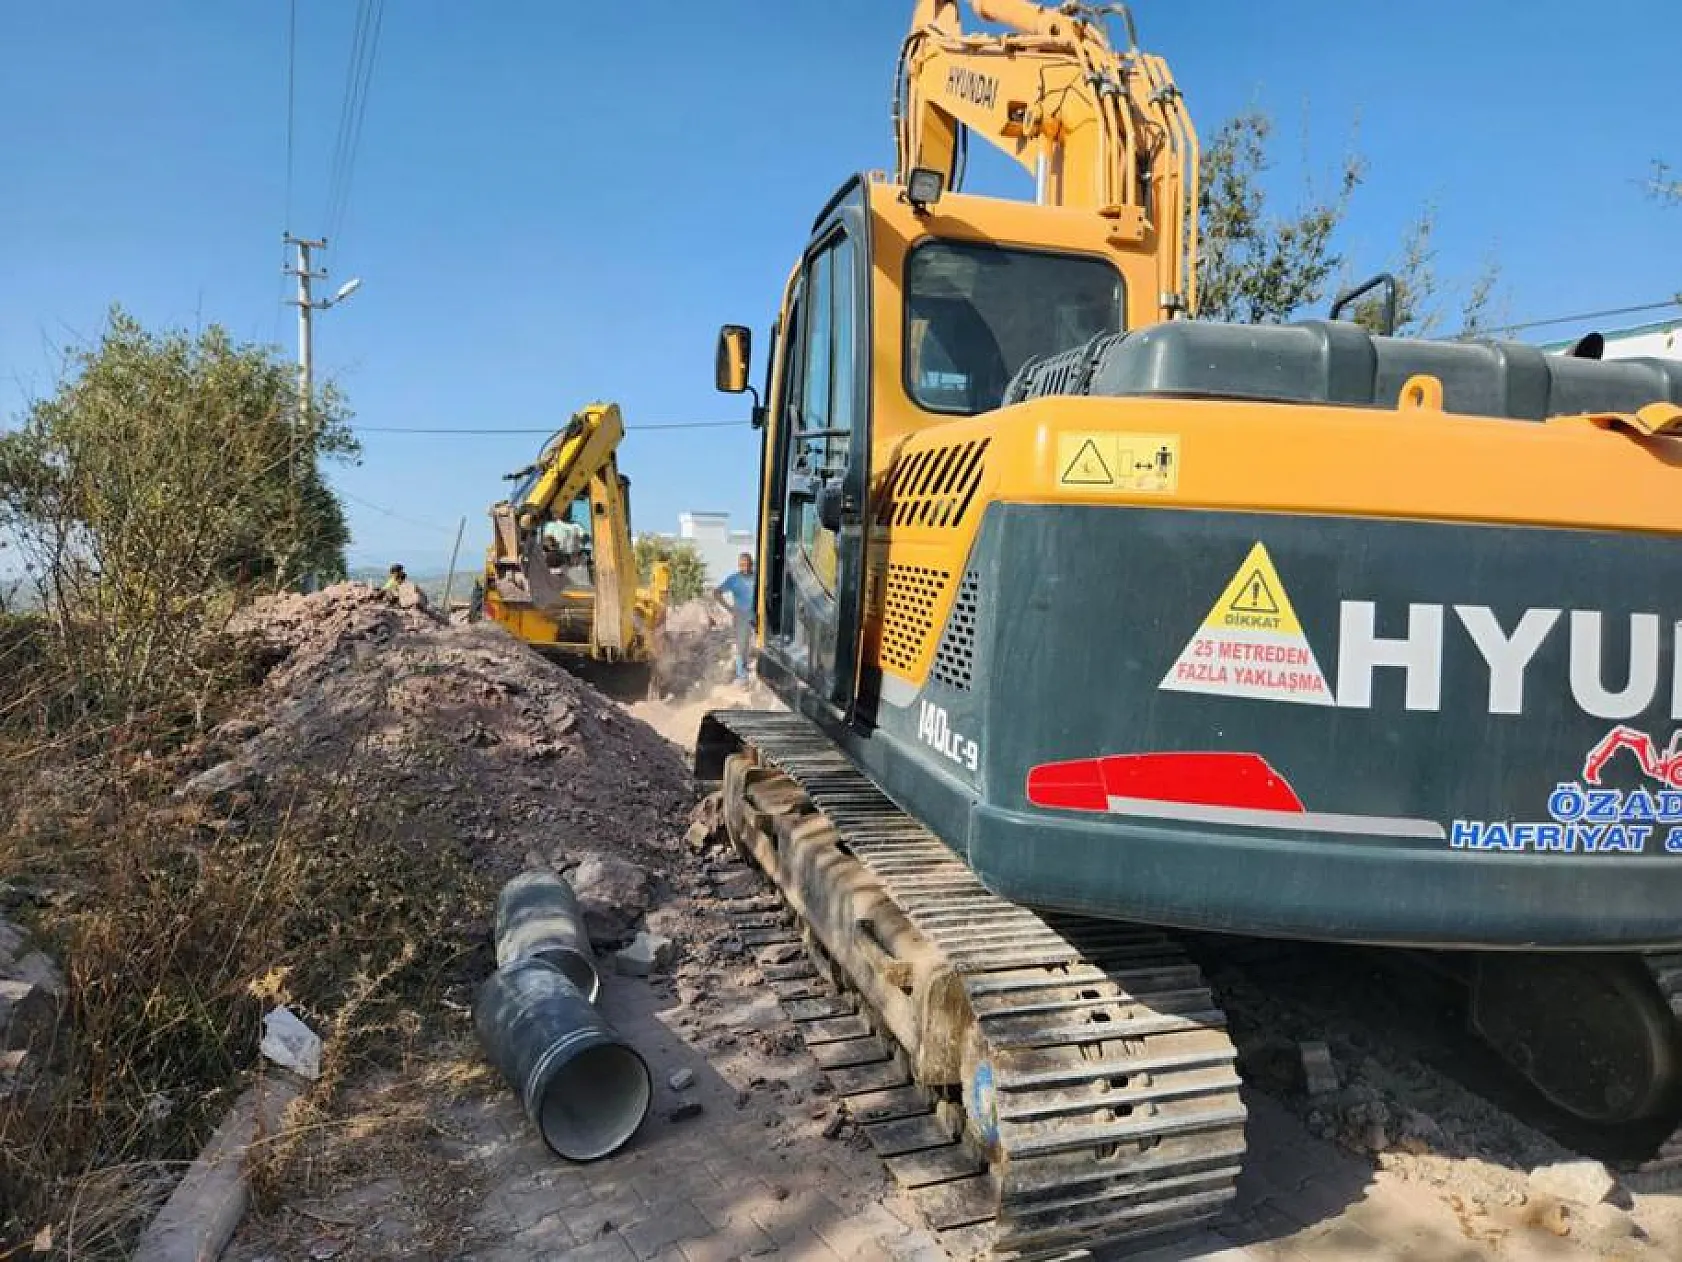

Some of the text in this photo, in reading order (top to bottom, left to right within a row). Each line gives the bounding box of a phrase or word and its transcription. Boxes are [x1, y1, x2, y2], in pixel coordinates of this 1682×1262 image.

[1194, 640, 1309, 664] 25 METREDEN
[1337, 600, 1682, 719] HYU
[1177, 664, 1228, 682] FAZLA
[1450, 820, 1653, 853] HAFRİYAT
